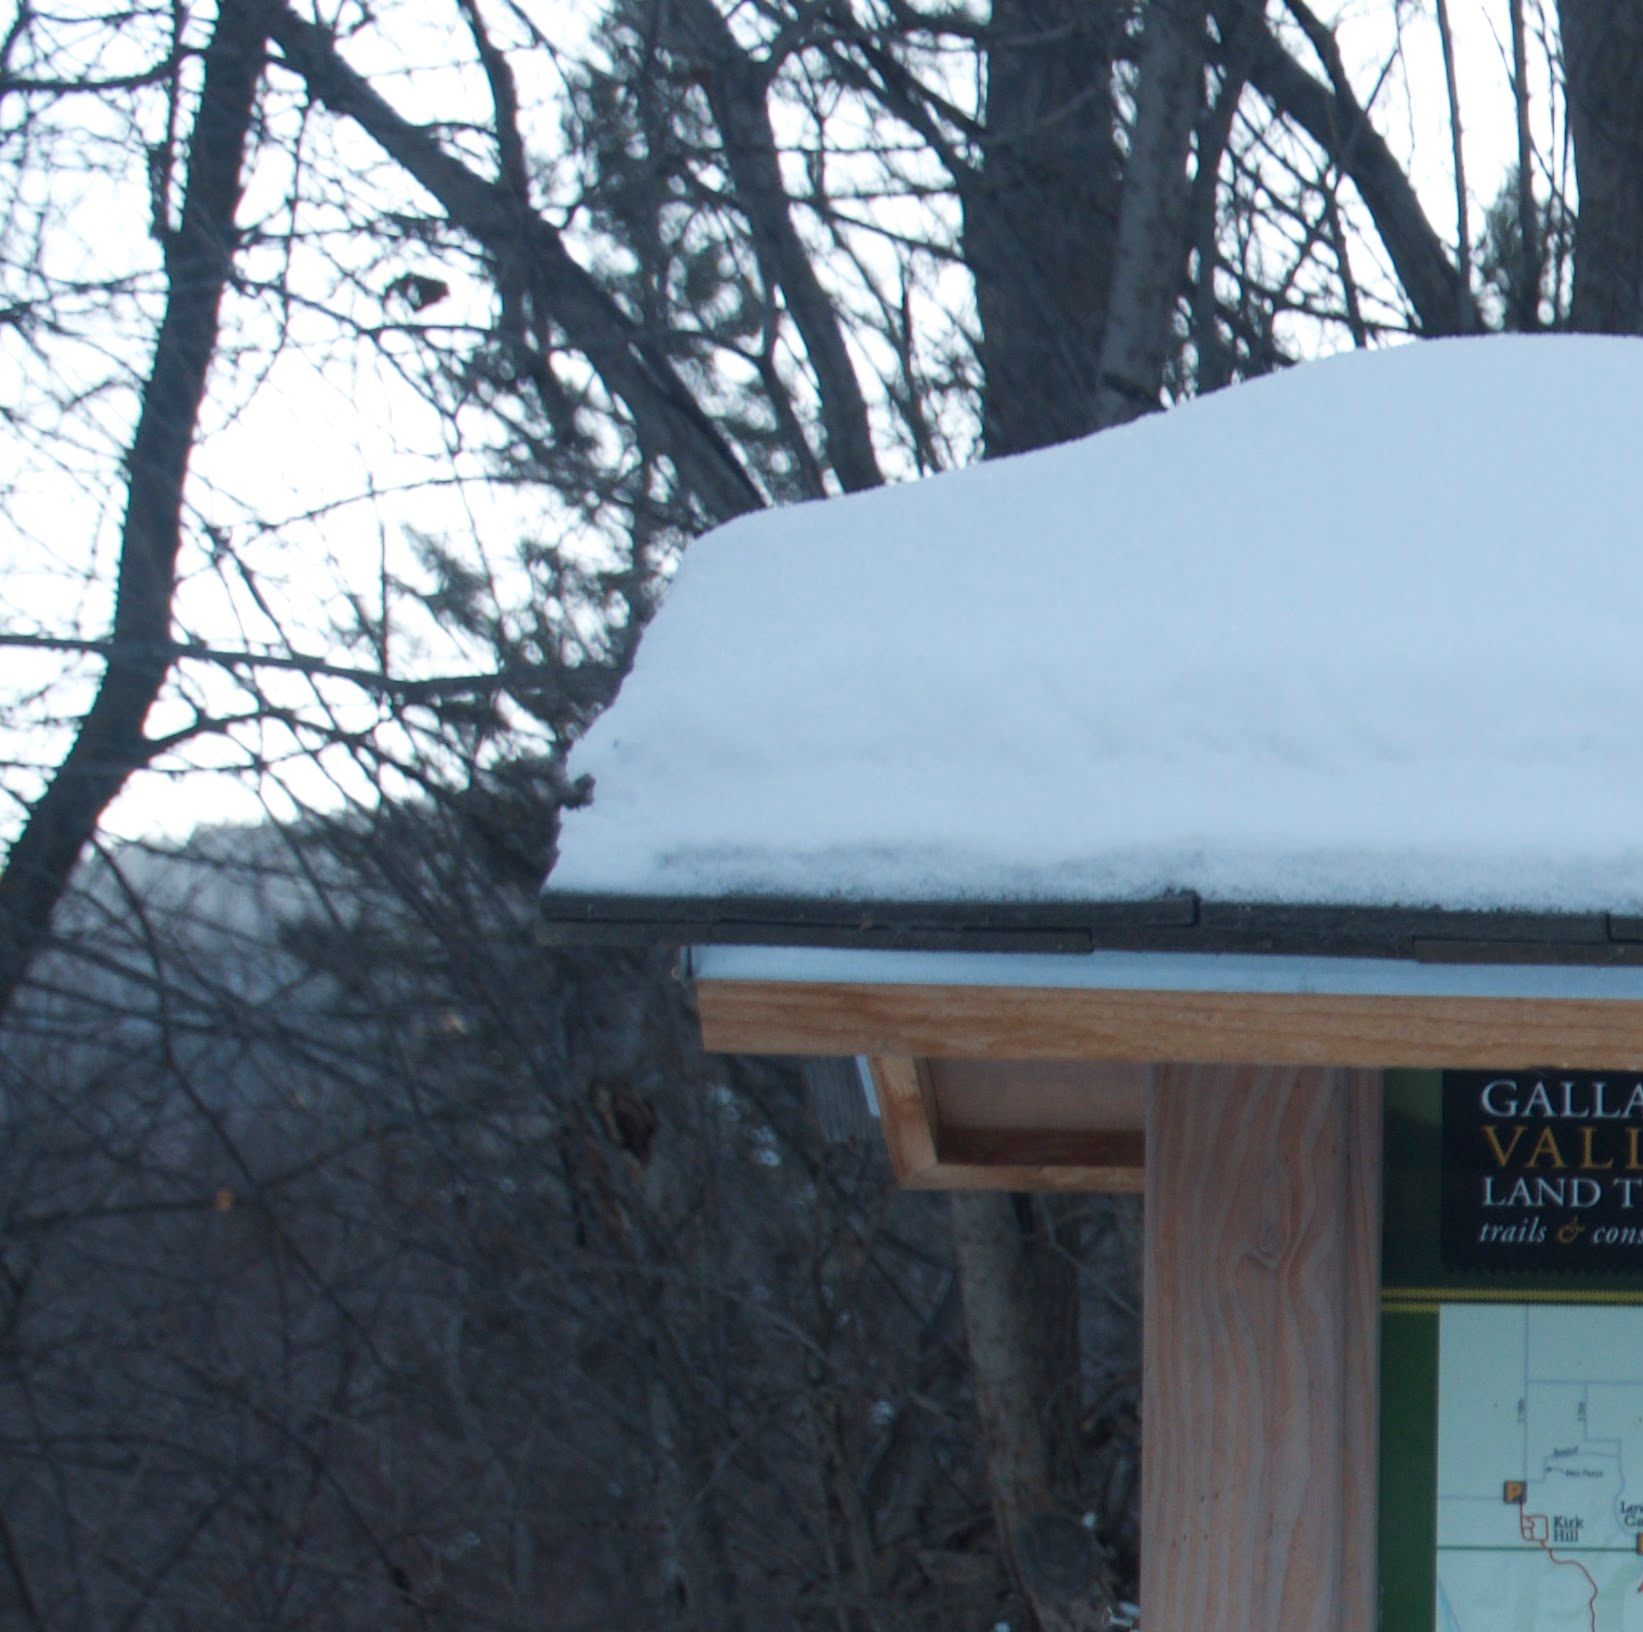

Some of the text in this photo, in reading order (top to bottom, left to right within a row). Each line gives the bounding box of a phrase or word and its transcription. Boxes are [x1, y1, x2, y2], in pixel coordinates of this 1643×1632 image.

[1483, 1177, 1601, 1207] LAND
[1479, 1216, 1547, 1243] trails
[1554, 1517, 1582, 1531] Kirk
[1554, 1529, 1578, 1542] Hill
